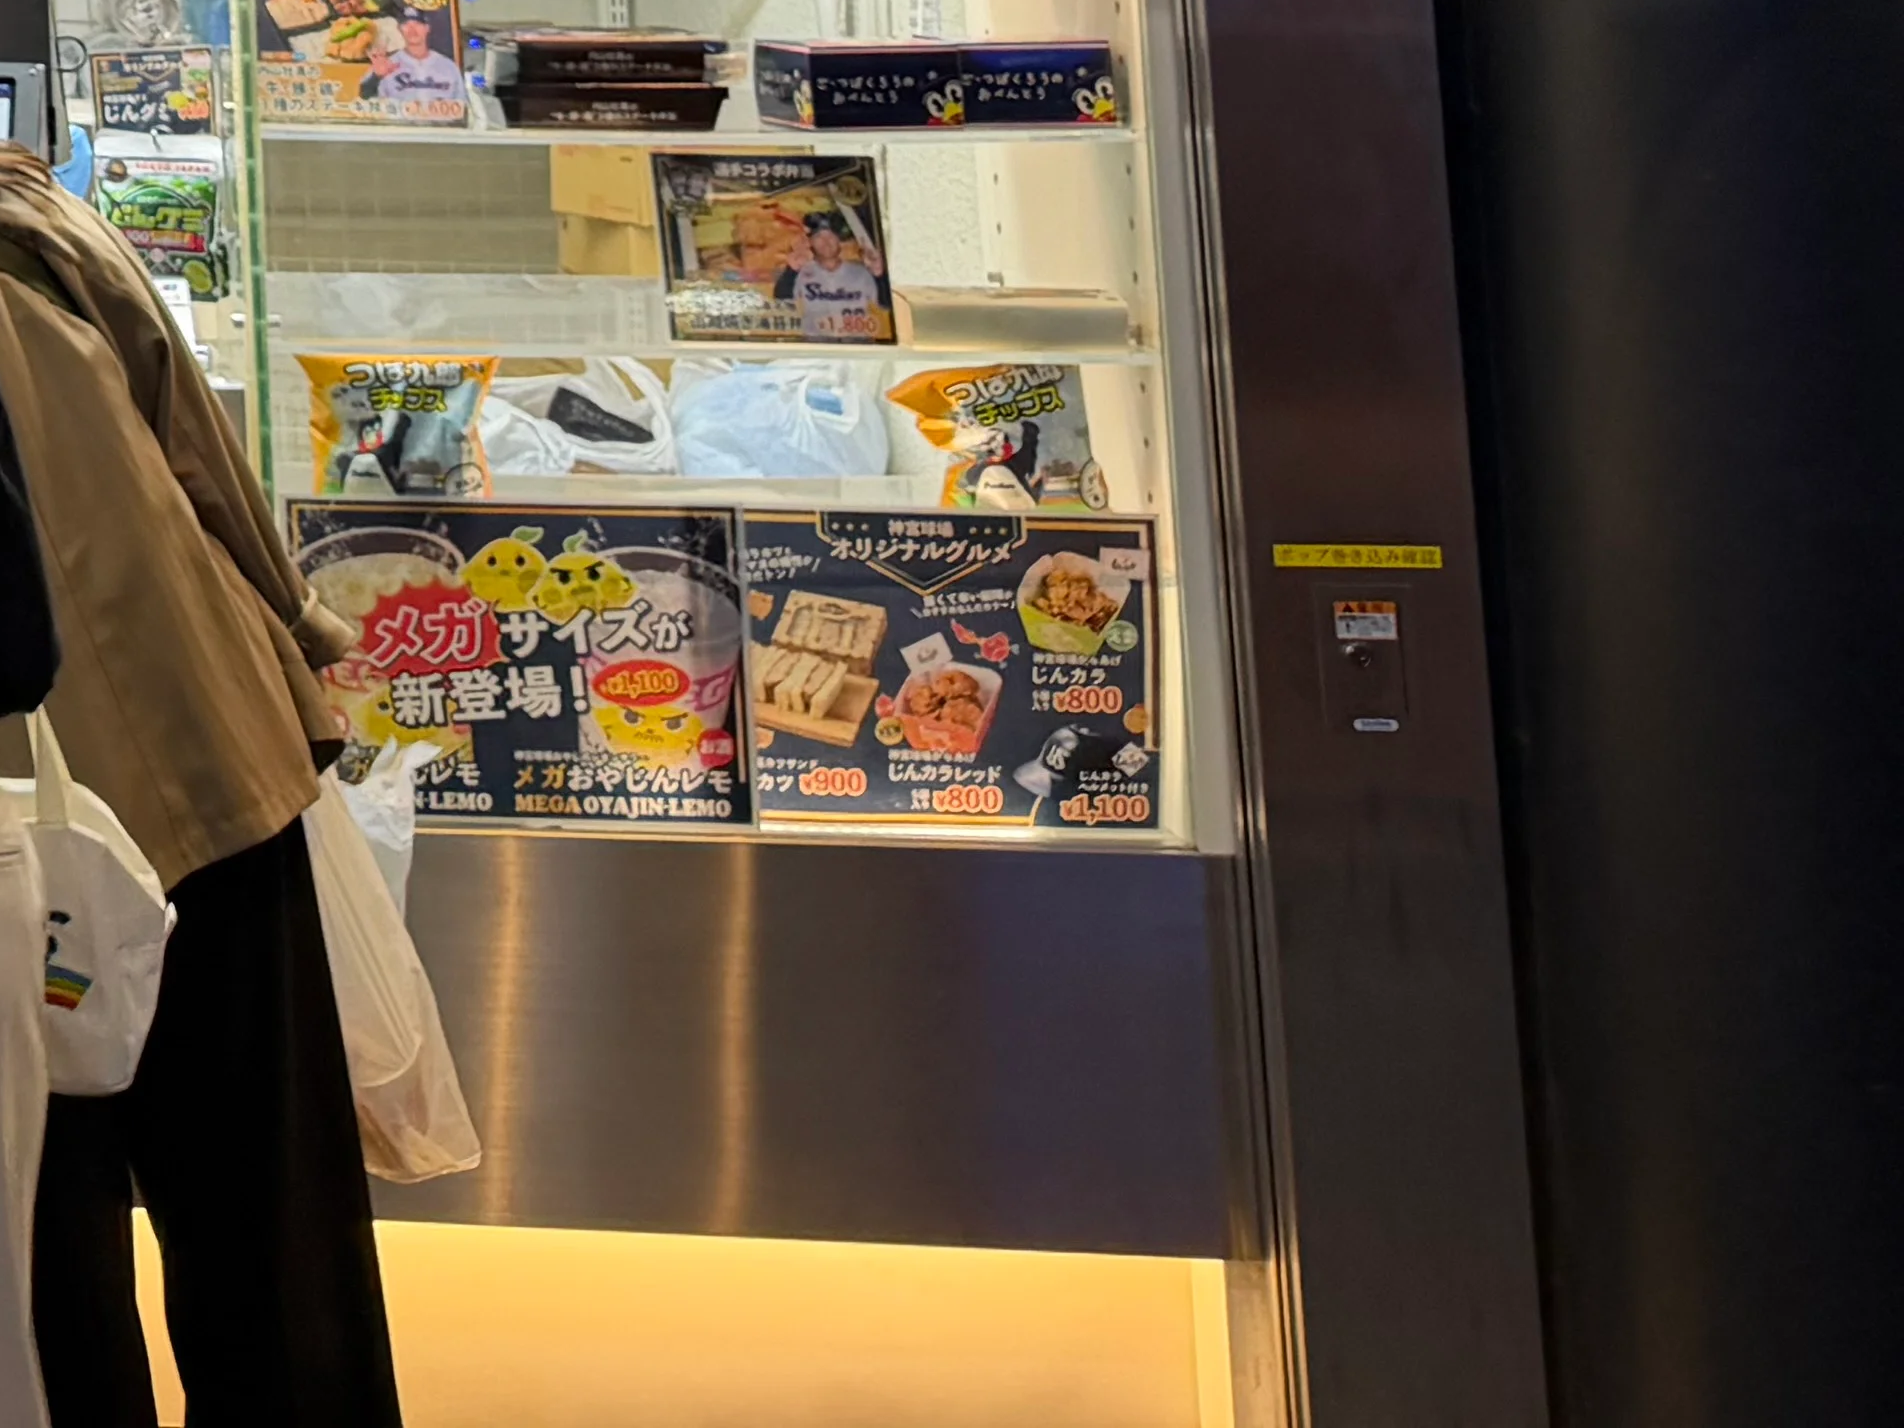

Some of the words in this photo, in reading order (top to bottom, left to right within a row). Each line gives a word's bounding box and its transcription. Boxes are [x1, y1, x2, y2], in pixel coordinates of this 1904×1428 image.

[345, 361, 464, 386] つば九郎
[948, 363, 1063, 403] つば九郎
[370, 387, 448, 413] チップス
[976, 386, 1063, 423] チップス
[888, 521, 954, 537] 神宮球場
[830, 539, 1014, 562] オリジナルグルメ
[371, 599, 692, 667] メガサイズが
[606, 674, 679, 697] ¥1,100
[1033, 667, 1105, 683] じんカラ
[393, 667, 589, 726] 新登場！
[1054, 687, 1121, 713] ¥800
[514, 766, 732, 794] メガおやじんレモ
[799, 769, 867, 796] ¥900
[888, 764, 1001, 783] じんカラレッド
[515, 795, 582, 814] MEGA
[584, 796, 732, 818] OYAJIN-LEMO
[933, 787, 1003, 812] ¥800
[1060, 796, 1150, 824] ¥1,100
